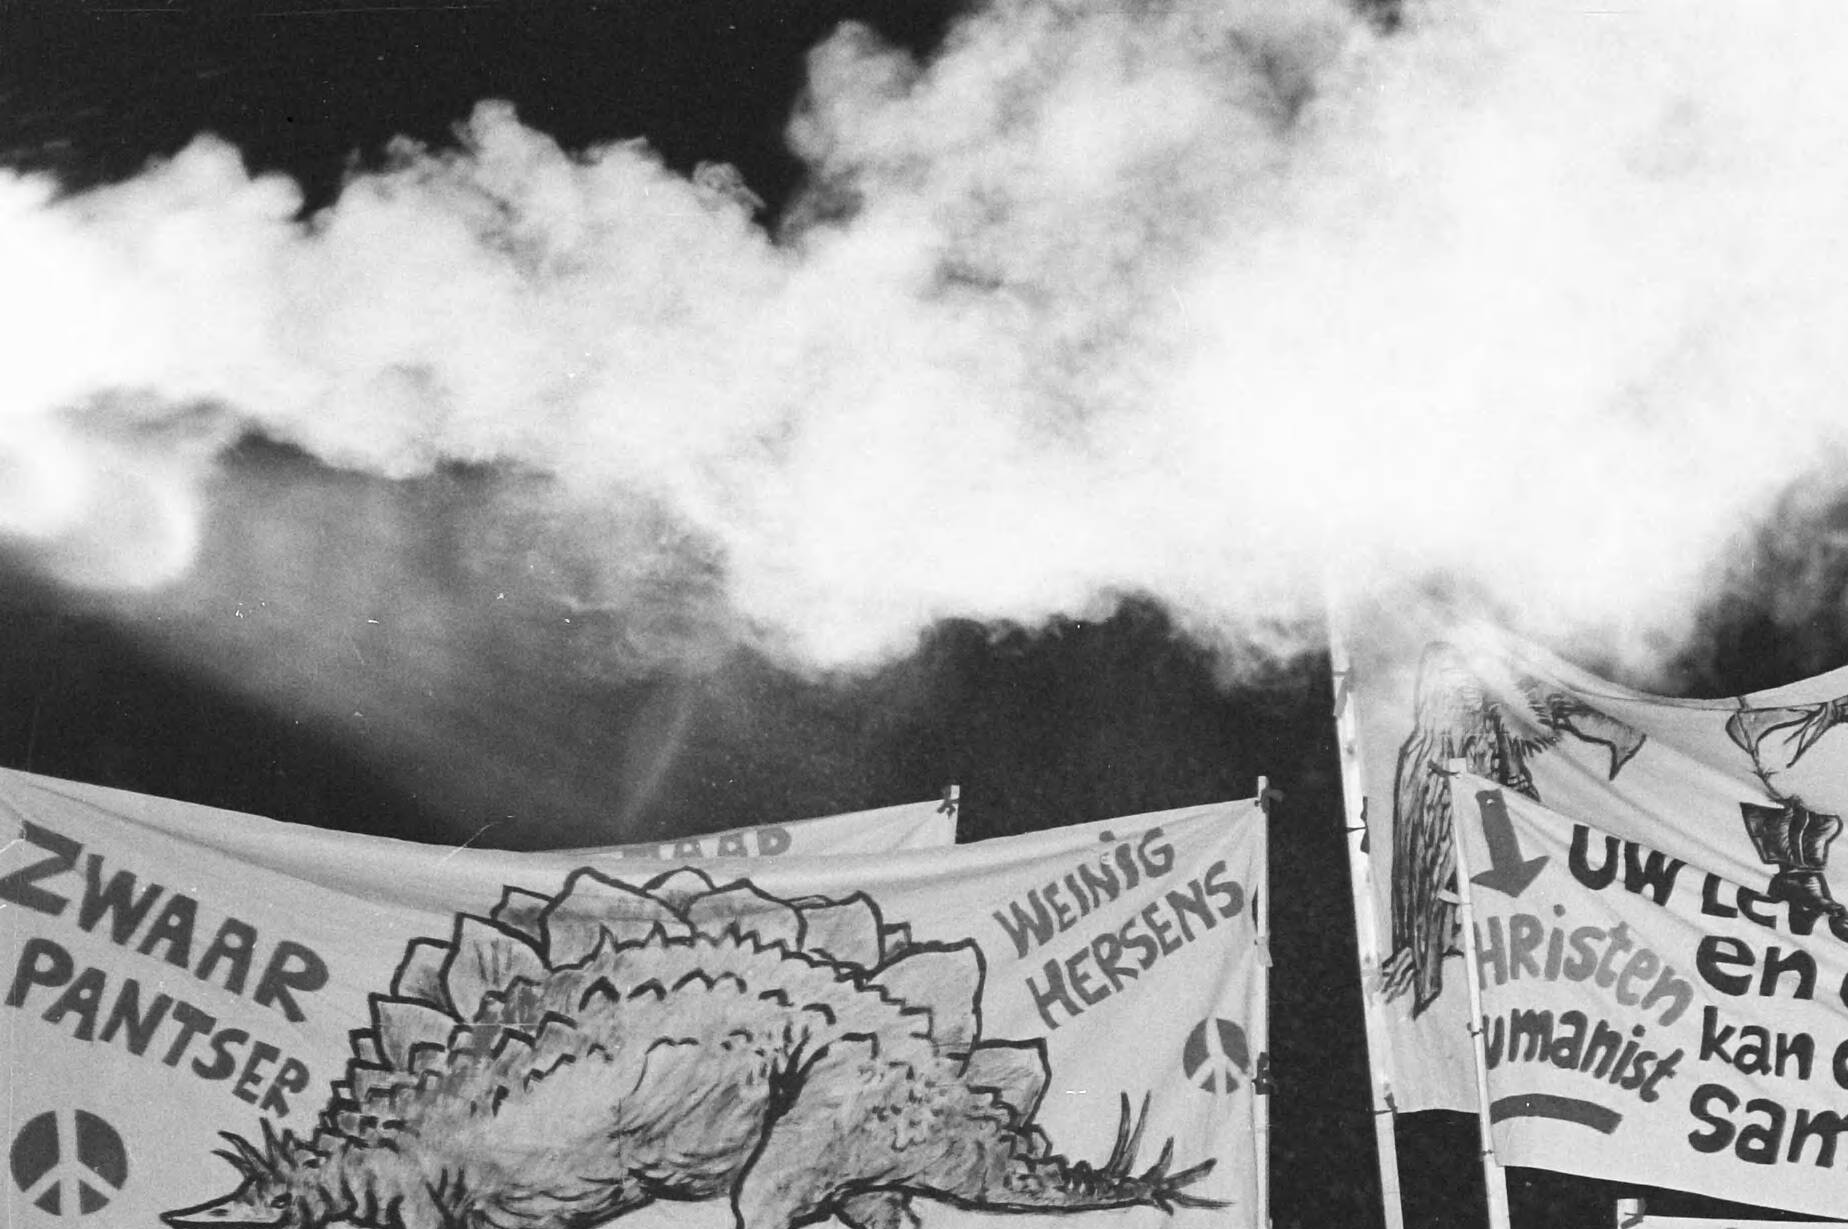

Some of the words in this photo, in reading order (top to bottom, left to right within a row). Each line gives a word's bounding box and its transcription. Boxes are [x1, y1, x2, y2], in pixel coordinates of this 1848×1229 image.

[0, 819, 330, 1023] ZWAAR
[992, 827, 1175, 960] WEINIG
[1026, 860, 1245, 1030] HERSENS
[8, 938, 310, 1118] PANTSER
[1696, 935, 1817, 1000] en
[1482, 1007, 1684, 1103] umanist
[1700, 1005, 1815, 1080] kan
